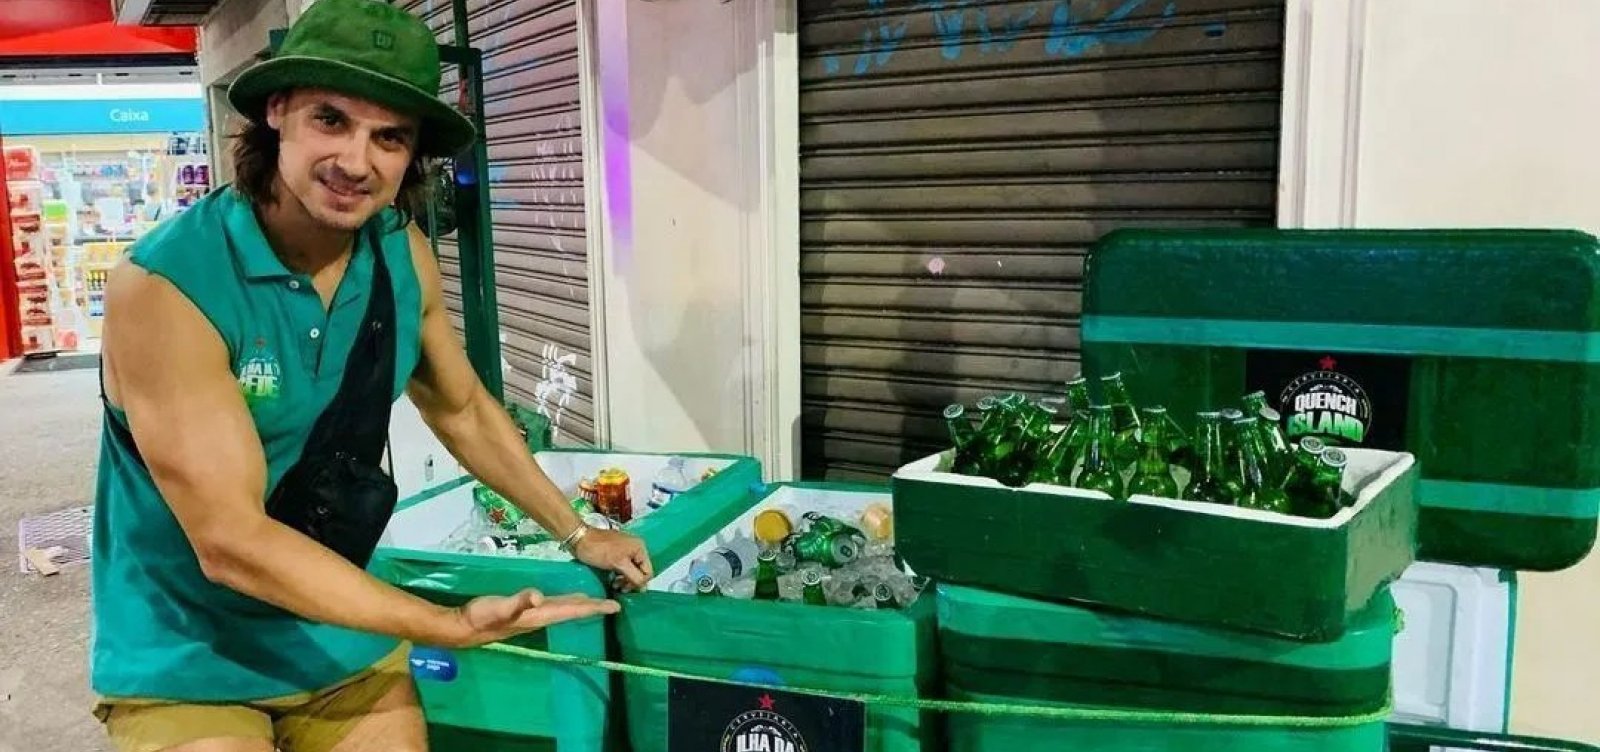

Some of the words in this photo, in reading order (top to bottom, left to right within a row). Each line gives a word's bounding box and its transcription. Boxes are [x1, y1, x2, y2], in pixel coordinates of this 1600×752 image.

[109, 108, 149, 122] Caixa
[1294, 392, 1357, 416] QUENCH
[1287, 410, 1364, 442] ISLAND
[736, 731, 770, 752] ILHA
